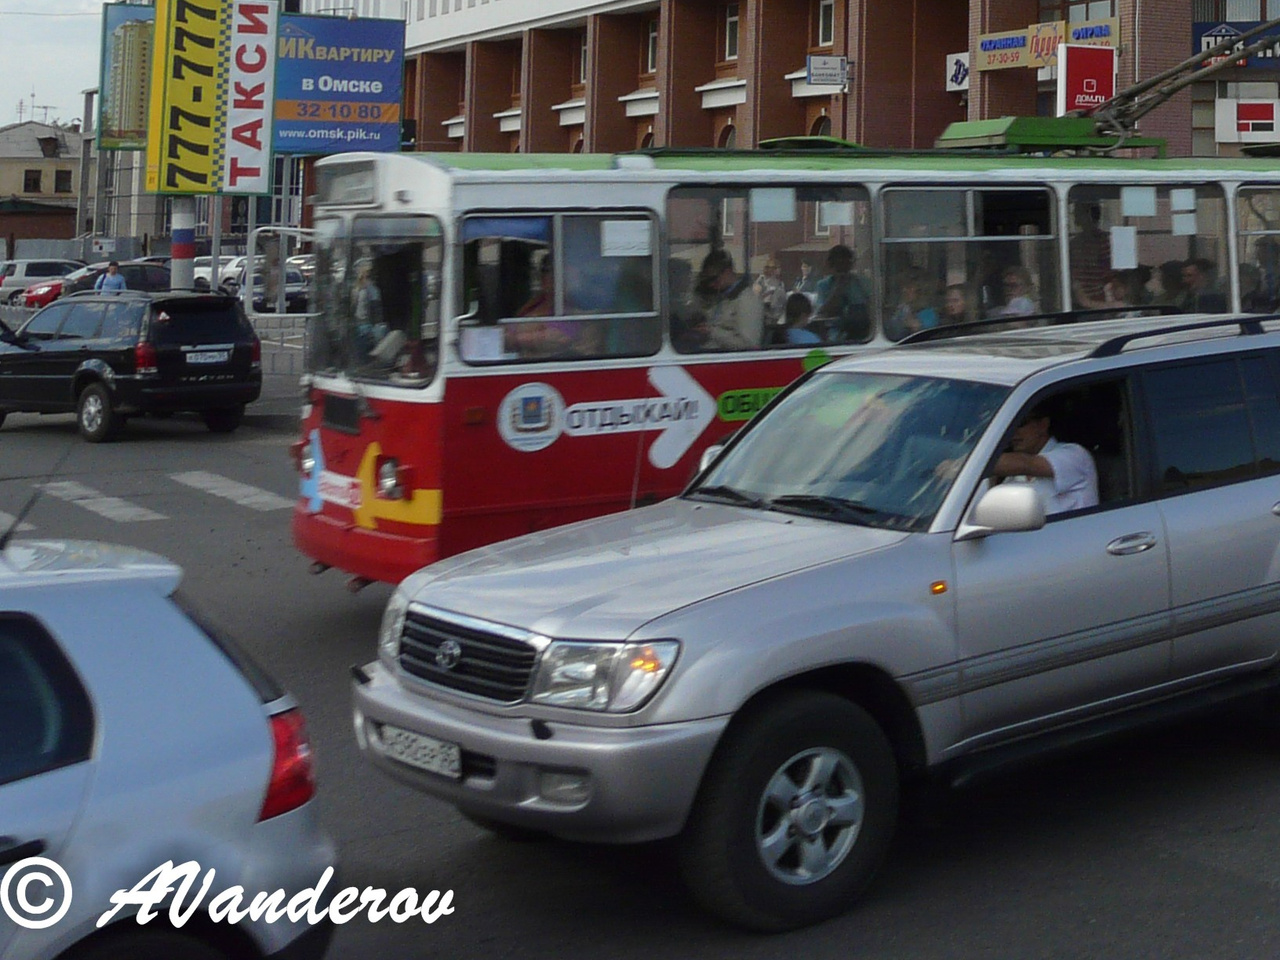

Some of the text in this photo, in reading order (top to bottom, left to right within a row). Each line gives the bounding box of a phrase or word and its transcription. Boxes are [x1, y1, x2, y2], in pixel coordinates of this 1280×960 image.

[229, 3, 270, 187] ТАКСИ
[318, 76, 383, 93] Омске
[279, 128, 381, 141] www.omsk.pik.ru
[566, 398, 700, 432] ОТДЫХАЙ!
